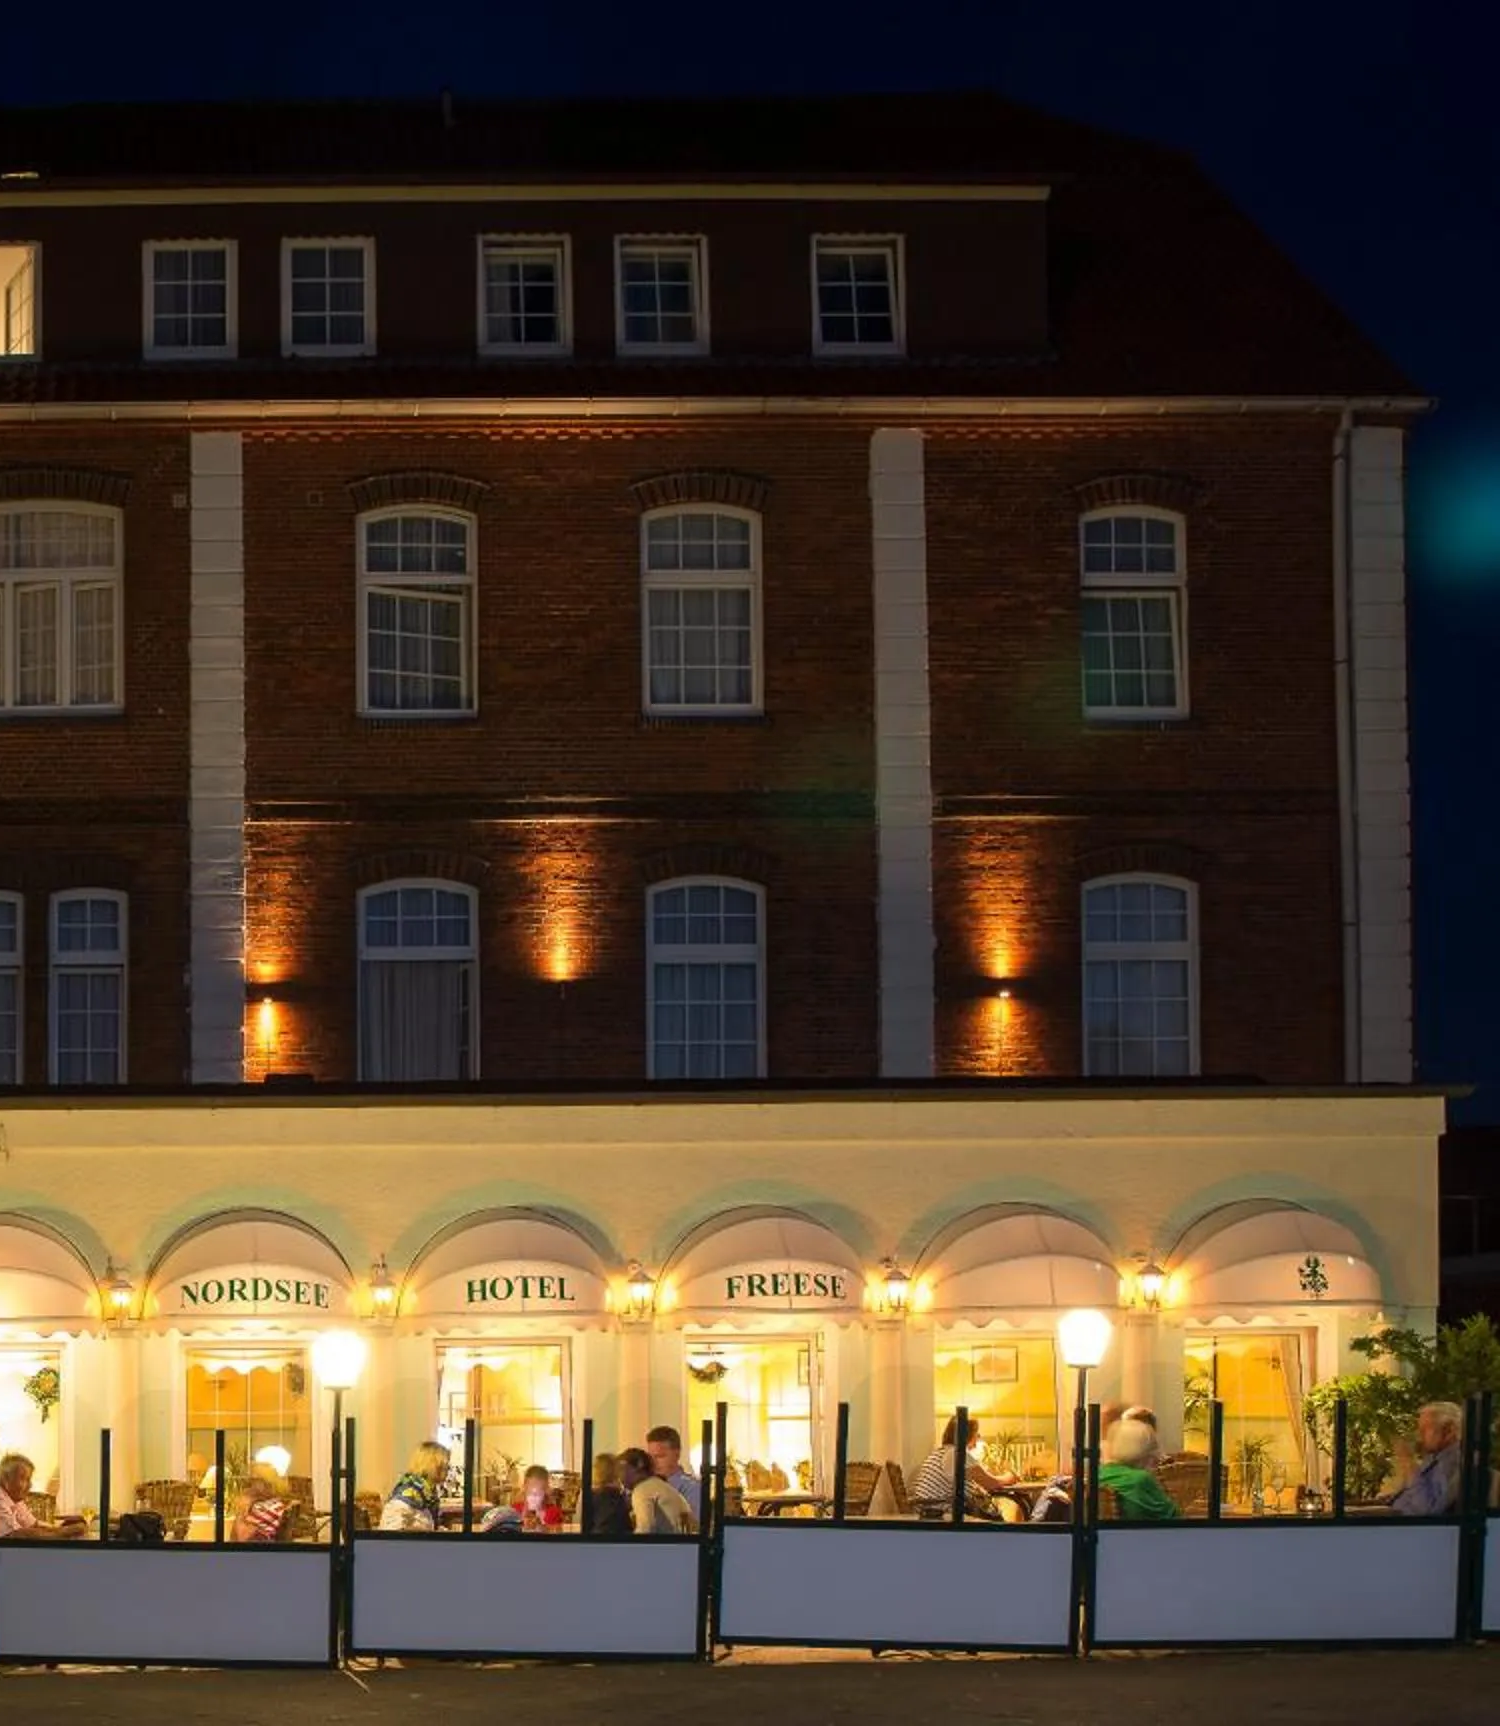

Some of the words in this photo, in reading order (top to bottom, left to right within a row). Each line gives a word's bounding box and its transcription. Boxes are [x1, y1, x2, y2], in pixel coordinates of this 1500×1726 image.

[180, 1277, 330, 1309] NORDSEE
[467, 1275, 575, 1303] HOTEL
[725, 1273, 847, 1300] FREESE
